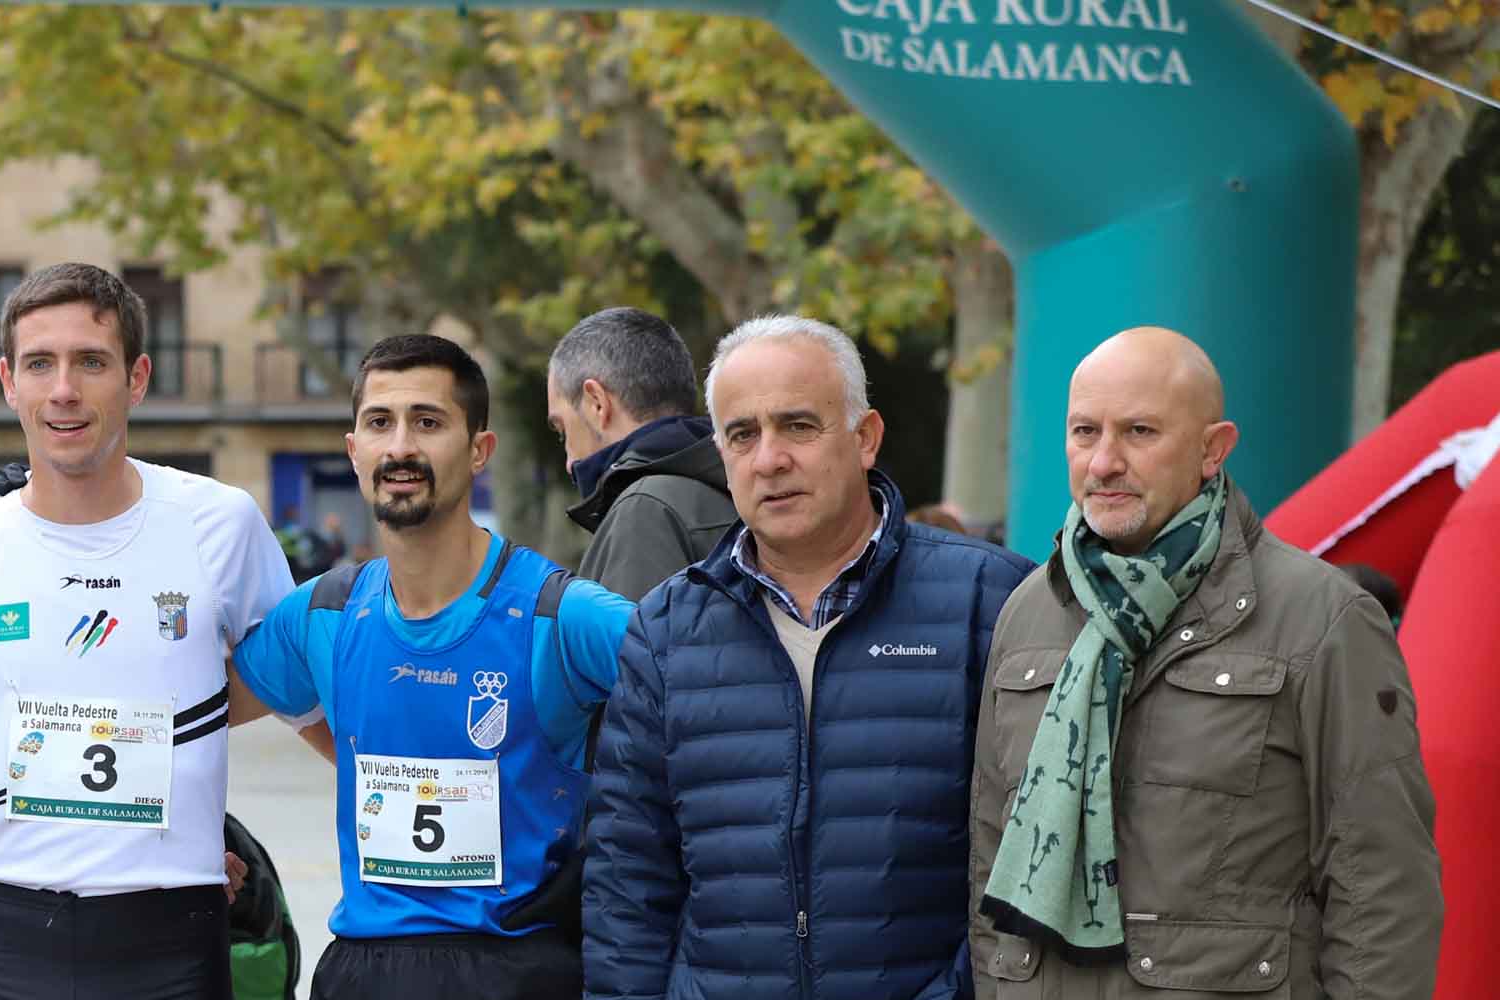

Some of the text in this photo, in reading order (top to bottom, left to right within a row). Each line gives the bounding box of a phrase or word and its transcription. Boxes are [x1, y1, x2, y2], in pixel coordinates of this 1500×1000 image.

[839, 26, 1192, 85] DE SALAMANCA
[85, 576, 121, 589] rasán
[882, 643, 937, 656] Columbia
[417, 667, 458, 686] rasán
[18, 699, 118, 720] VII Vuelta Pedestre
[21, 718, 82, 732] a Salamanca
[80, 743, 118, 792] 3
[360, 761, 440, 779] VII Vuelta Pedestre
[372, 779, 410, 792] Salamanca
[134, 797, 164, 805] DIEGO
[30, 804, 162, 819] CAJA RURAL DE SALAMANCA
[412, 804, 445, 853] 5
[450, 854, 496, 862] ANTONIO
[378, 866, 493, 877] CAJA RURAL DE SALAMANCA
